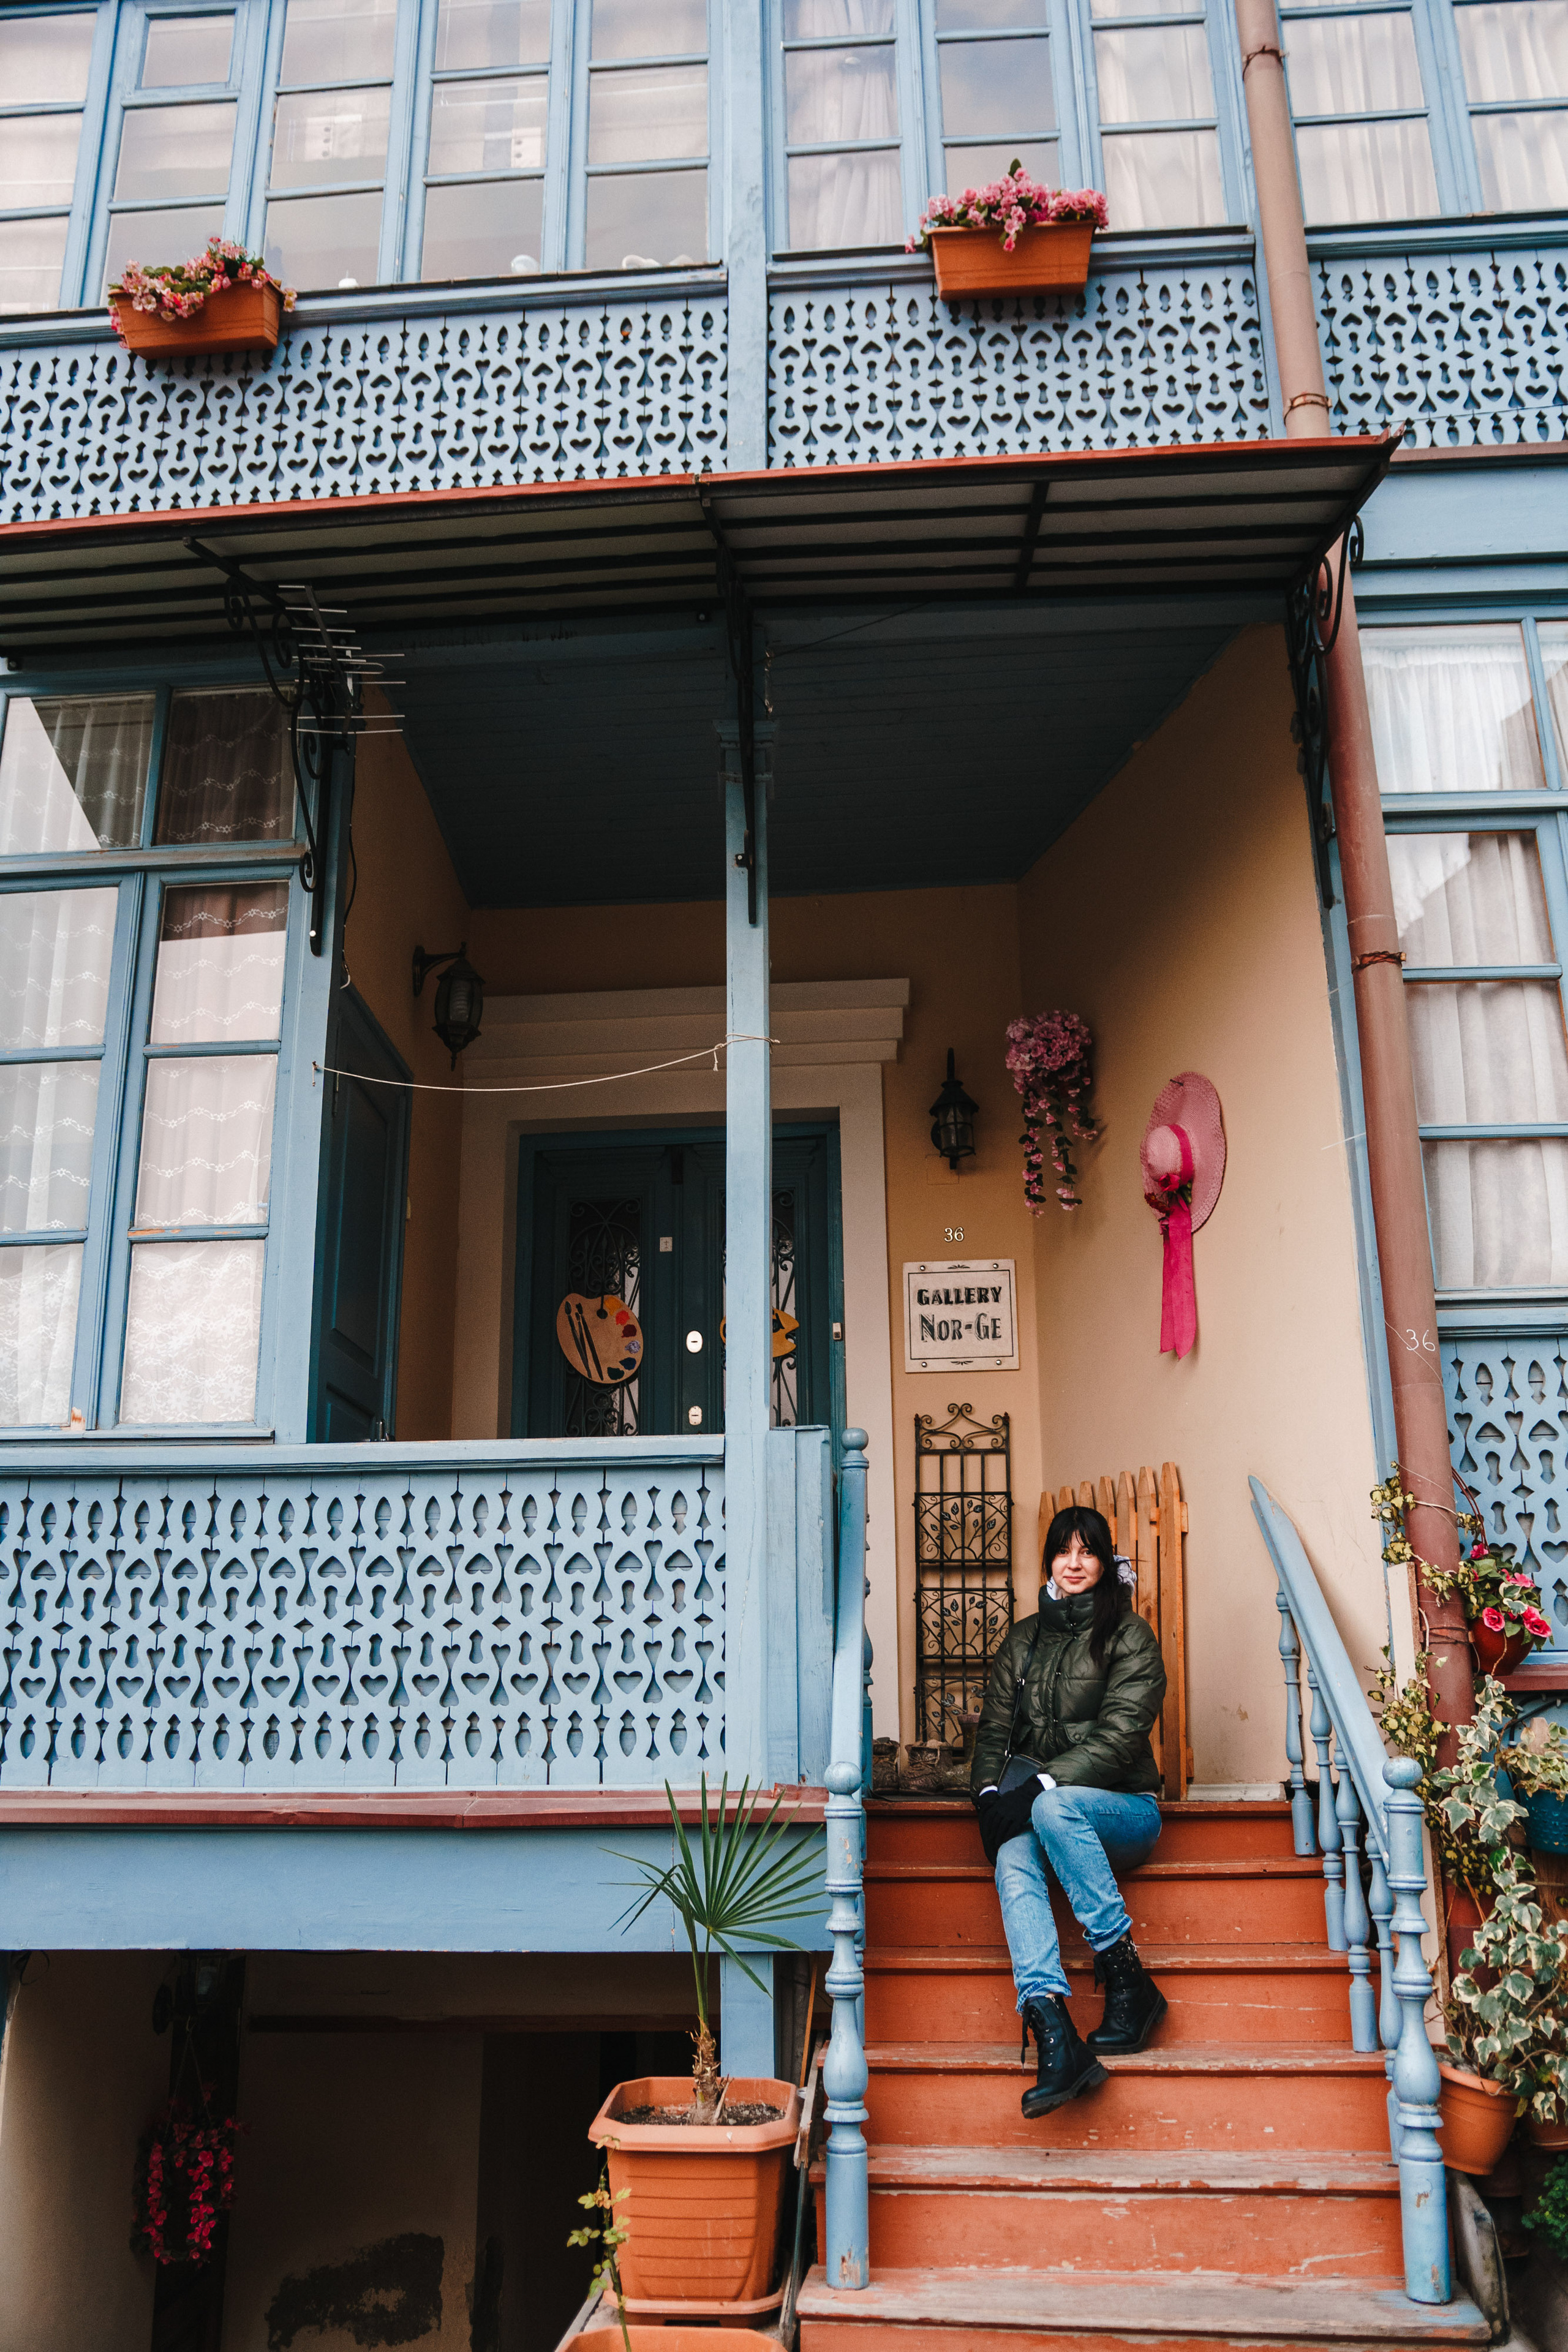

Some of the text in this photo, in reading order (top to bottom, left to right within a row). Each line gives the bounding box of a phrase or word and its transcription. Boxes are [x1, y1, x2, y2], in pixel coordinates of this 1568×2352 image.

[944, 1227, 964, 1242] 36
[917, 1286, 1002, 1306] GALLERY
[1406, 1329, 1436, 1352] 36
